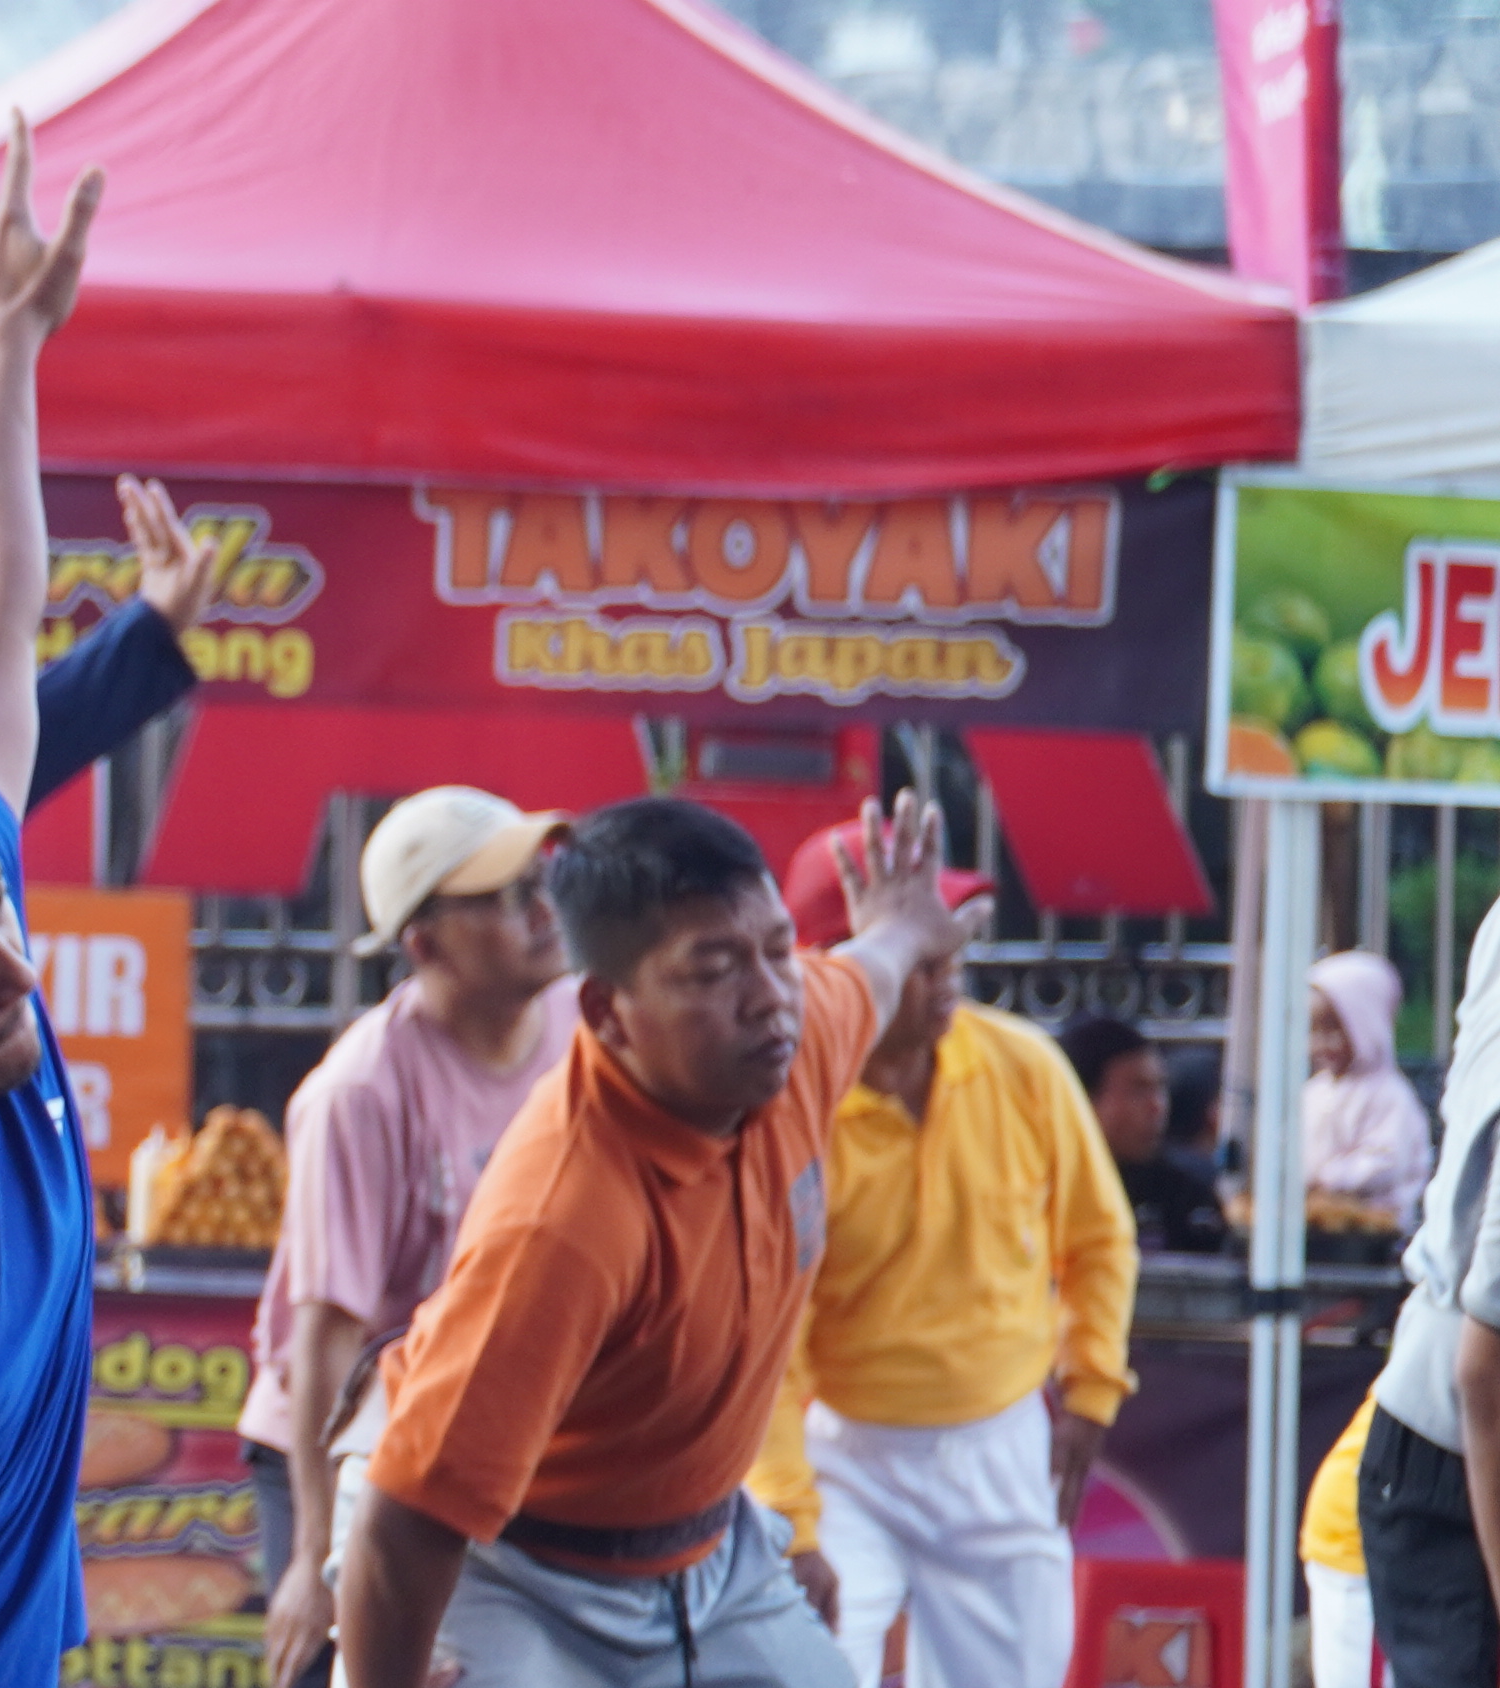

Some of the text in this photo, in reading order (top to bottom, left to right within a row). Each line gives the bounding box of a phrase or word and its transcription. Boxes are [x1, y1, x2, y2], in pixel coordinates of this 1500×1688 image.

[422, 490, 1114, 618] TAKOYAKI
[503, 614, 1020, 694] Khas Japan
